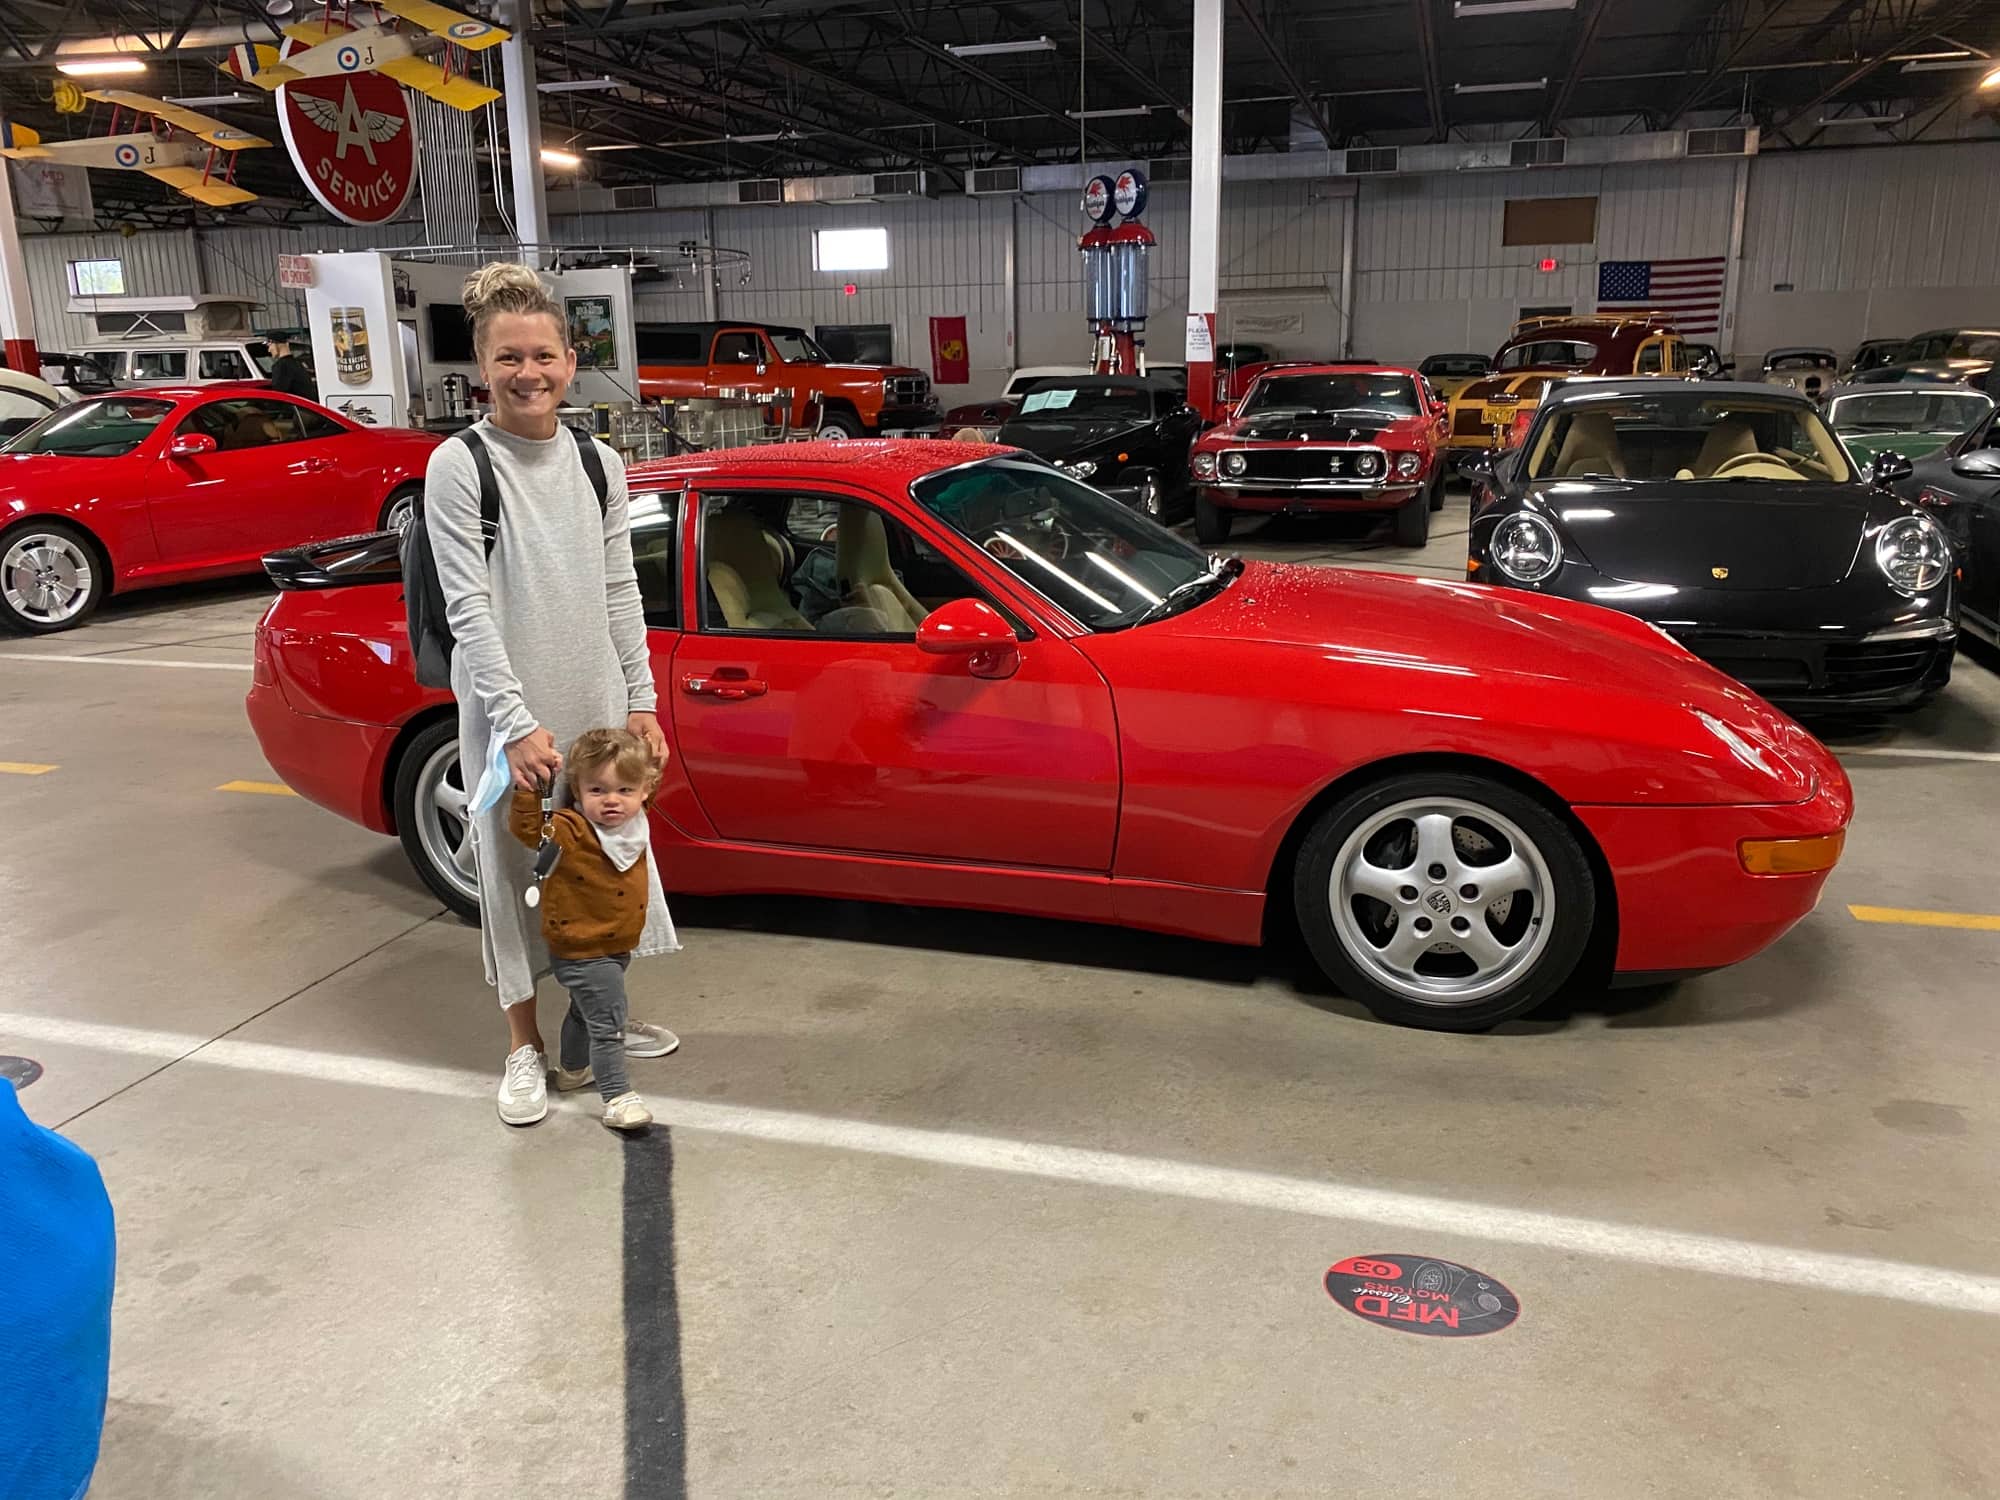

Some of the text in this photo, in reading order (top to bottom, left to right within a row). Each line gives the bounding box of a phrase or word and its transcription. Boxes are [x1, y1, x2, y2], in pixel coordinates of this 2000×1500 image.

[364, 46, 375, 65] J
[336, 79, 377, 165] A
[144, 146, 156, 164] J
[316, 158, 397, 208] SERVICE
[355, 361, 368, 371] OIL
[1353, 1261, 1391, 1276] 03
[1352, 1287, 1414, 1305] Classic
[1363, 1281, 1450, 1303] MOTORS
[1354, 1295, 1460, 1329] MFD
